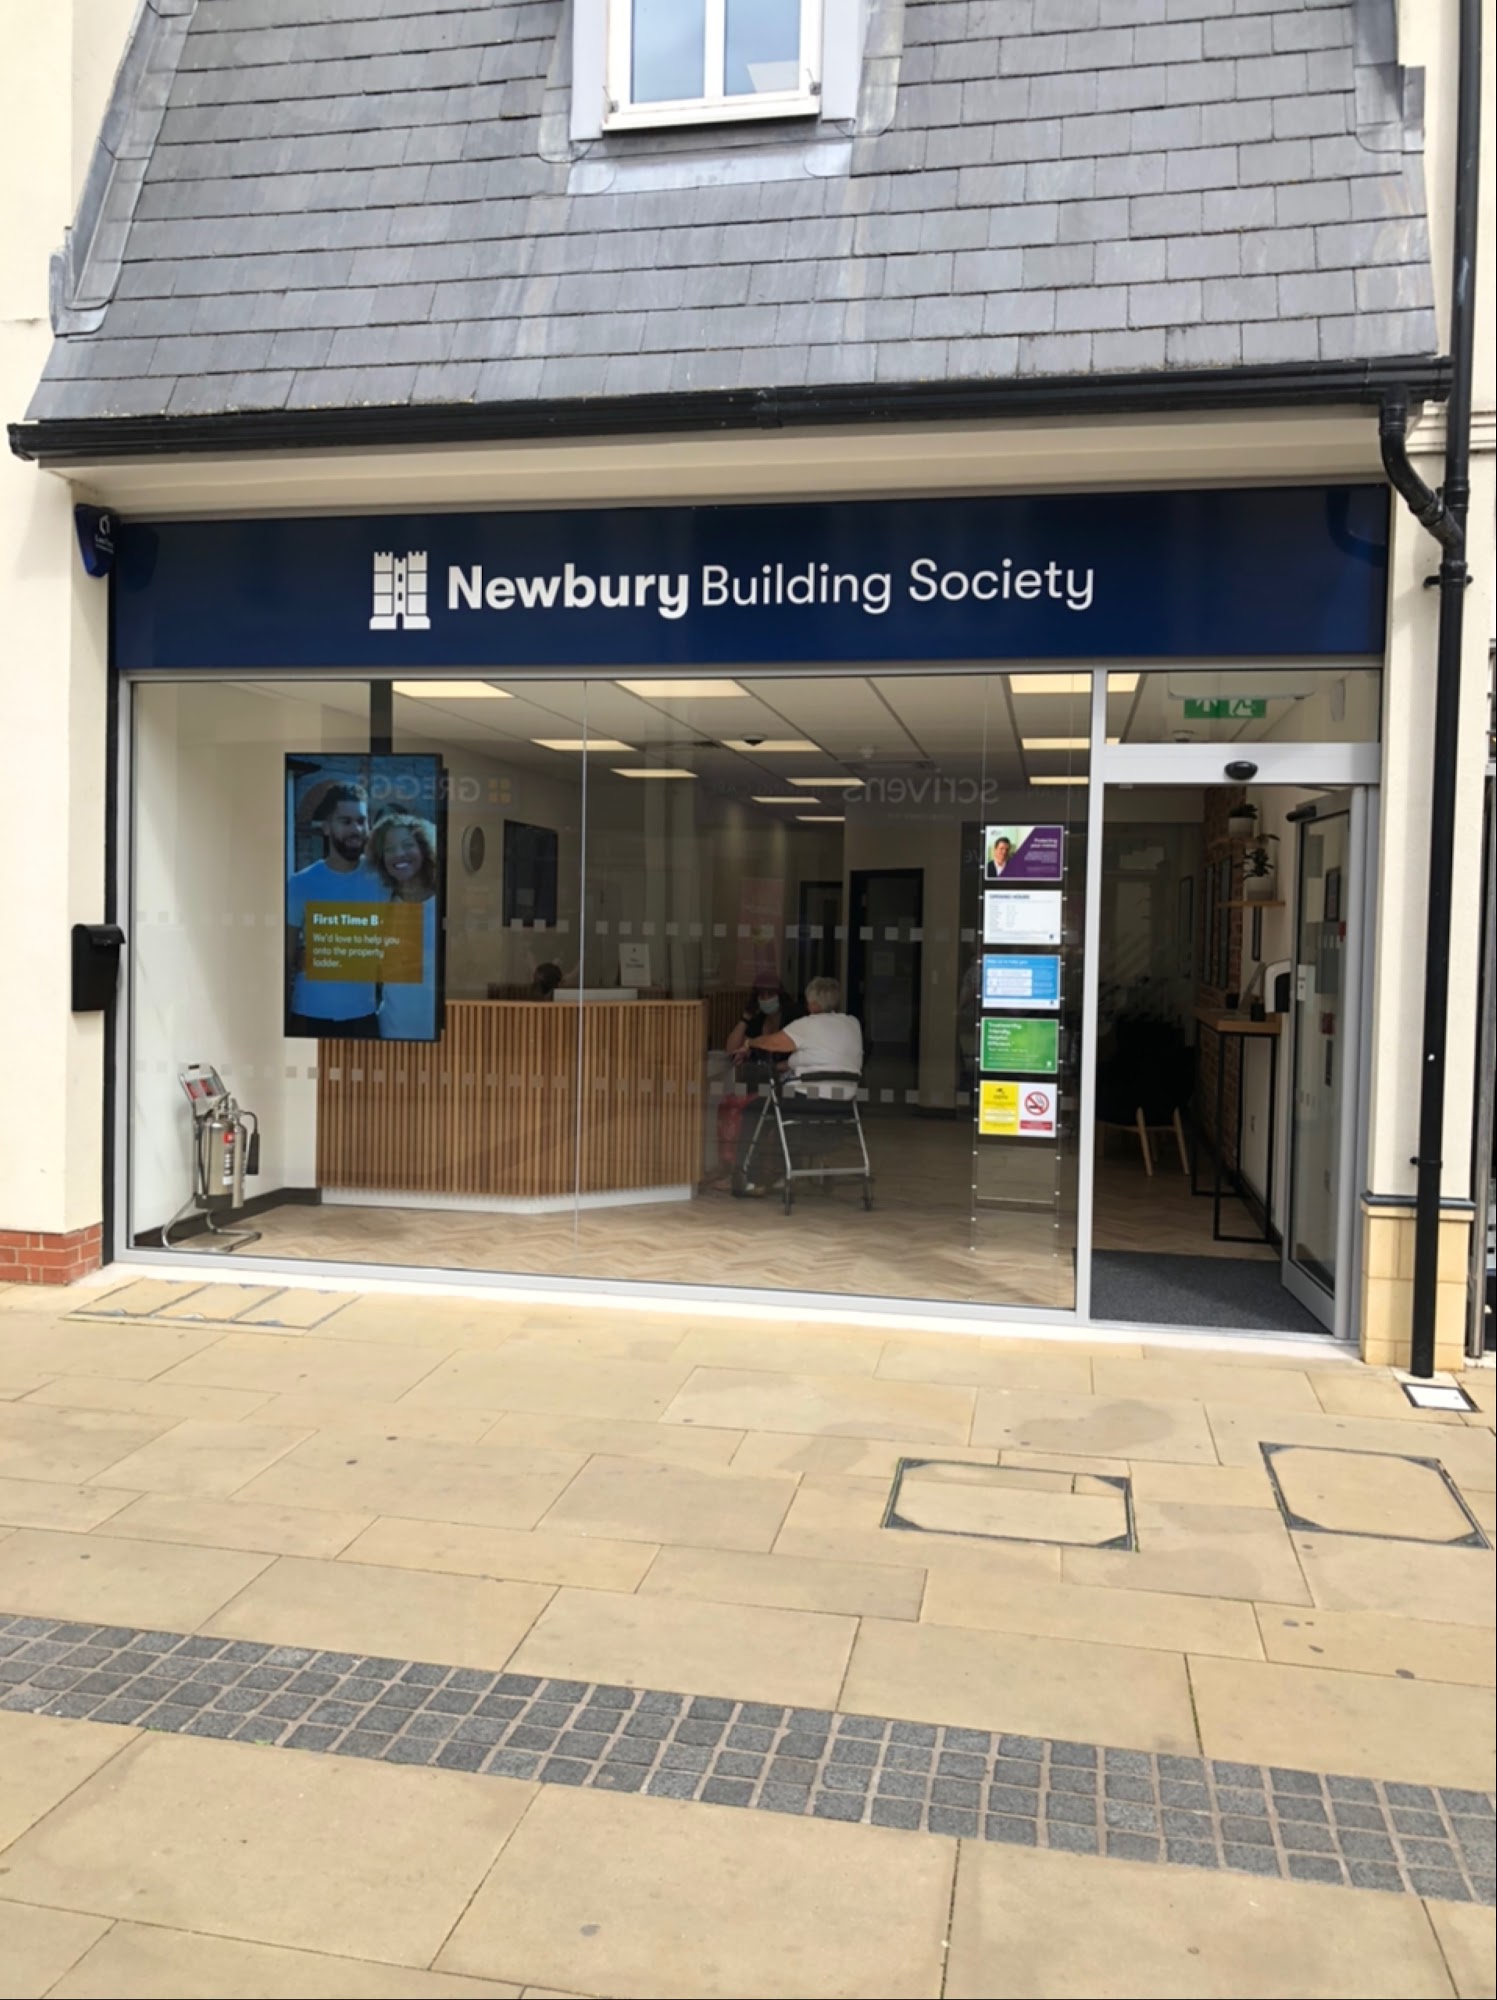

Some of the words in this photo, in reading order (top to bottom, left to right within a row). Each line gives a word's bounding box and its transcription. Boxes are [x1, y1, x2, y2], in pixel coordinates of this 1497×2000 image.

[448, 563, 690, 619] Newbury
[702, 563, 891, 613] Building
[909, 558, 1095, 610] Society
[313, 912, 338, 925] First
[340, 913, 369, 926] Time
[313, 933, 334, 943] We'd
[335, 933, 352, 943] love
[353, 934, 362, 943] to
[363, 934, 382, 946] help
[383, 936, 400, 947] you
[313, 947, 332, 956] onto
[333, 947, 347, 956] the
[348, 948, 384, 960] property
[313, 957, 342, 968] ladder.
